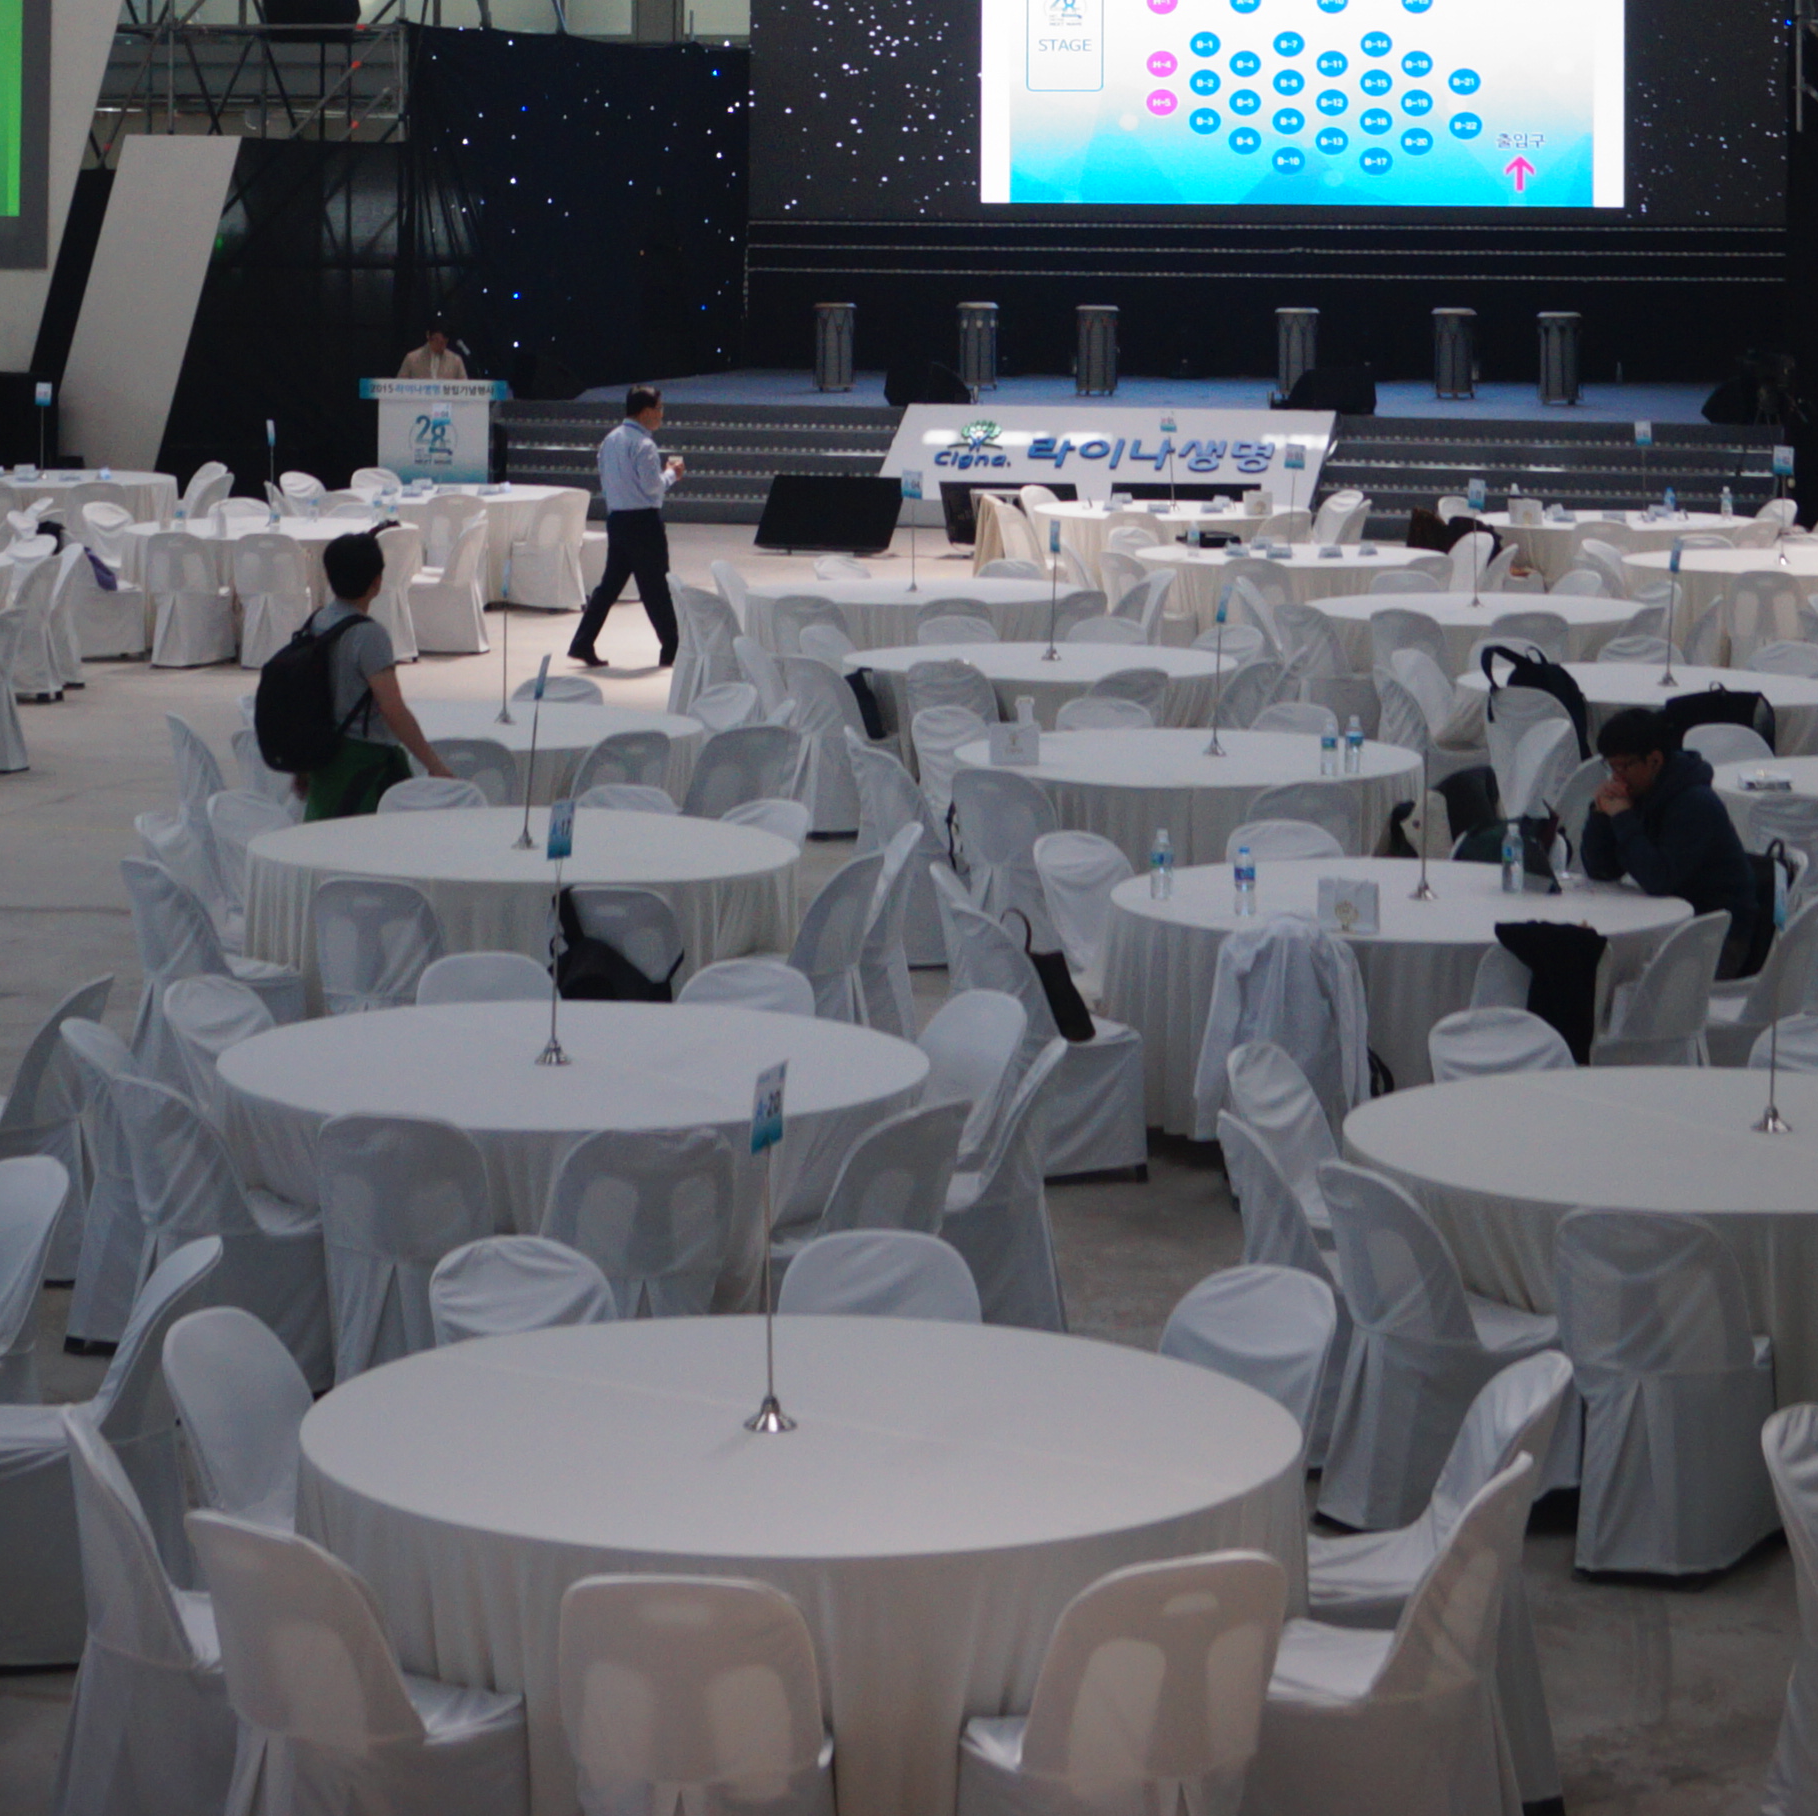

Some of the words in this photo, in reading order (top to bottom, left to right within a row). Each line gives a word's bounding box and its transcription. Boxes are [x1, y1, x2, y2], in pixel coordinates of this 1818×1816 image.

[1038, 38, 1093, 52] STAGE
[1496, 132, 1546, 150] 출입구
[370, 384, 394, 394] 2015
[1027, 437, 1276, 474] 라이나생명
